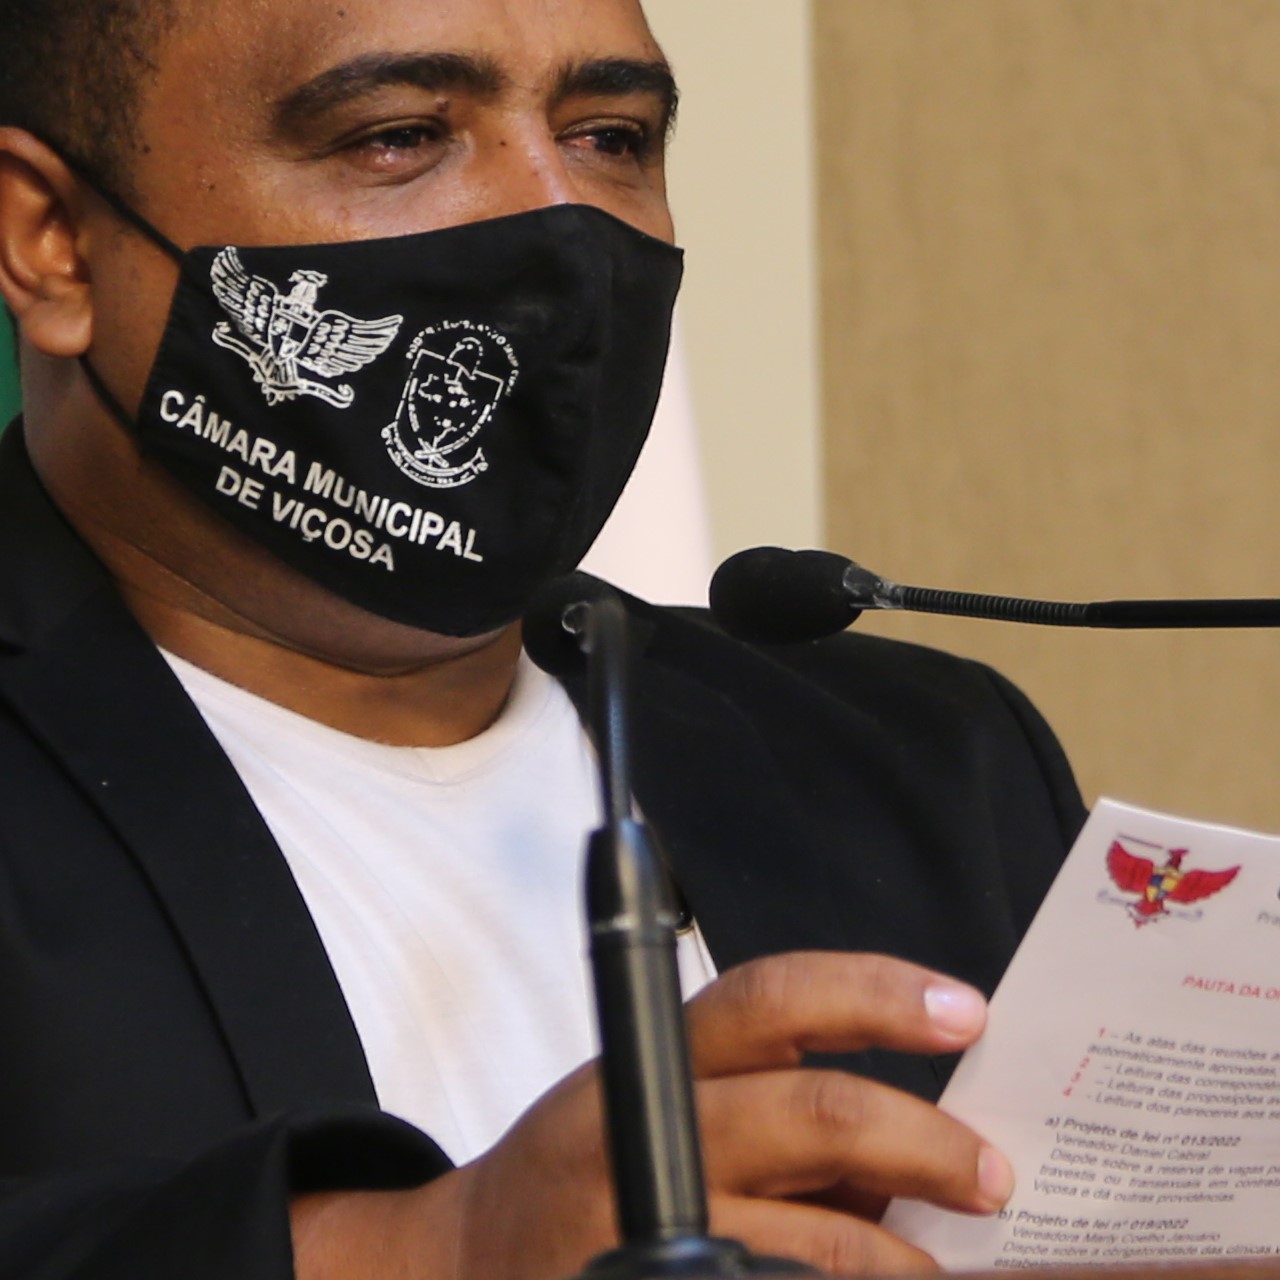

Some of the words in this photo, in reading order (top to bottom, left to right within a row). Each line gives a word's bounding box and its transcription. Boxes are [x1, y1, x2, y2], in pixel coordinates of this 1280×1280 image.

[160, 390, 296, 484] CÂMARA
[303, 461, 483, 563] MUNICIPAL
[214, 465, 265, 510] DE
[272, 491, 395, 571] VIÇOSA
[1182, 975, 1235, 994] PAUTA
[1239, 984, 1261, 999] DA
[1125, 1032, 1142, 1045] As
[1147, 1037, 1176, 1051] atas
[1180, 1041, 1206, 1055] das
[1088, 1043, 1206, 1069] automaticamente
[1116, 1063, 1163, 1081] Leitura
[1166, 1072, 1192, 1085] das
[1095, 1092, 1143, 1109] Leitura
[1107, 1079, 1155, 1096] Leitura
[1158, 1086, 1183, 1100] das
[1063, 1118, 1116, 1136] Projeto
[1120, 1129, 1138, 1140] de
[1142, 1131, 1160, 1143] lei
[1056, 1132, 1119, 1152] Vereador
[1121, 1143, 1165, 1158] Daniel
[1167, 1150, 1212, 1161] Cabral
[1102, 1157, 1141, 1172] sobre
[1104, 1174, 1122, 1186] ou
[1016, 1210, 1068, 1228] Projeto
[1072, 1218, 1089, 1229] de
[1013, 1226, 1080, 1243] Vereadora
